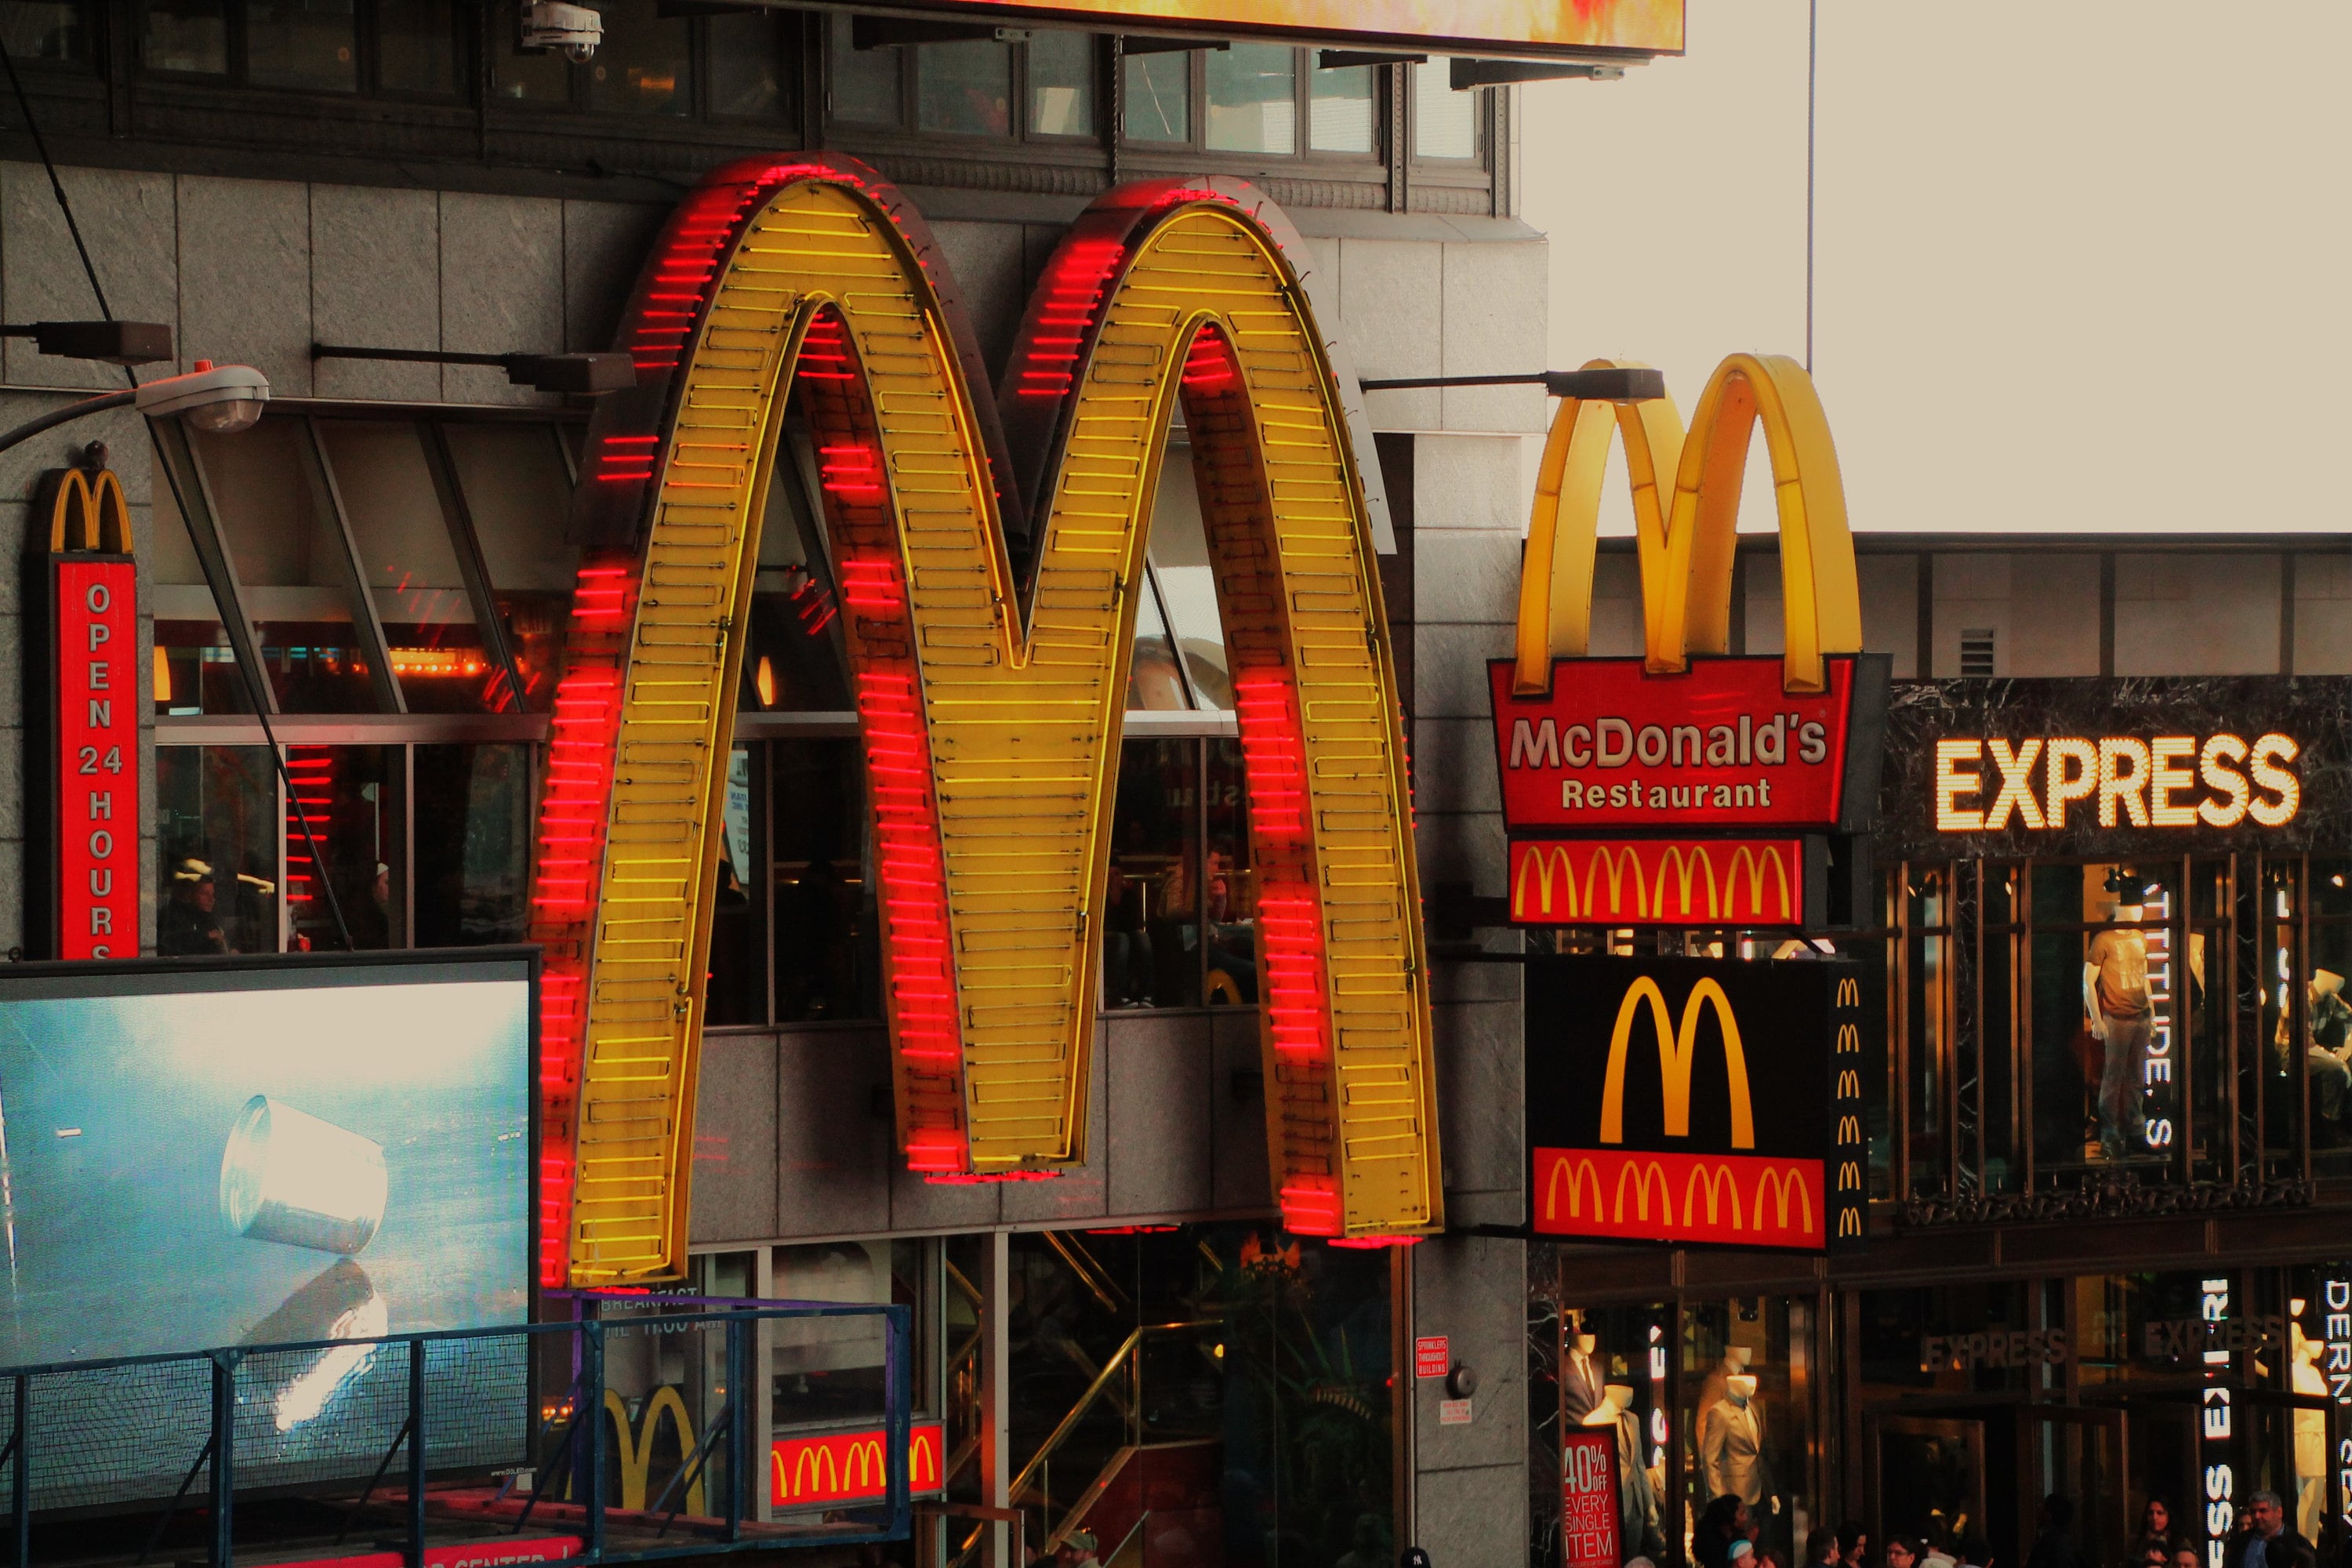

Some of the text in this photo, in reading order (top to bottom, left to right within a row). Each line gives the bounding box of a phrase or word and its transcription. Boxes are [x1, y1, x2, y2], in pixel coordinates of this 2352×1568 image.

[85, 583, 111, 728] OPEN
[1508, 713, 1828, 769] McDonald's
[78, 746, 122, 775] 24
[1561, 778, 1773, 810] Restaurant
[1935, 733, 2300, 832] EXPRESS
[1417, 1339, 1446, 1350] SPRINKLERS
[1921, 1327, 2068, 1372] EXPRESS
[2145, 1314, 2285, 1357] EXPRESS
[1418, 1363, 1446, 1374] BUILDING
[1592, 1475, 1607, 1492] OFF
[1565, 1494, 1608, 1514] EVERY
[1565, 1512, 1610, 1533] SINGLE
[1565, 1530, 1613, 1560] ITEM
